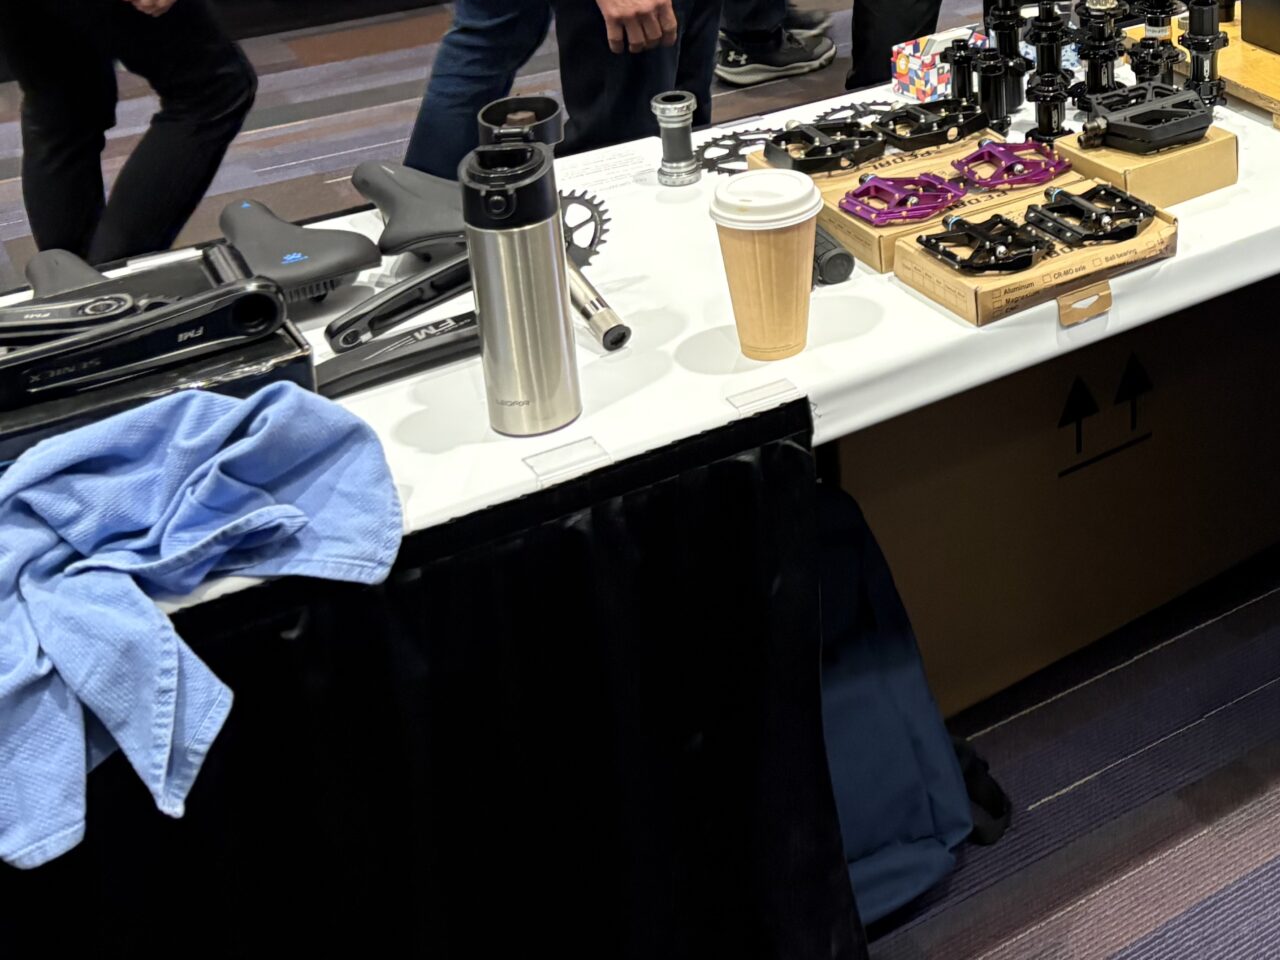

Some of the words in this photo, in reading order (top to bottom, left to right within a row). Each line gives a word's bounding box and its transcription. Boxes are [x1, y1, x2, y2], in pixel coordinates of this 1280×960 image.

[1105, 253, 1116, 263] Ball
[1116, 247, 1138, 260] bearing
[1003, 281, 1035, 295] Aluminum
